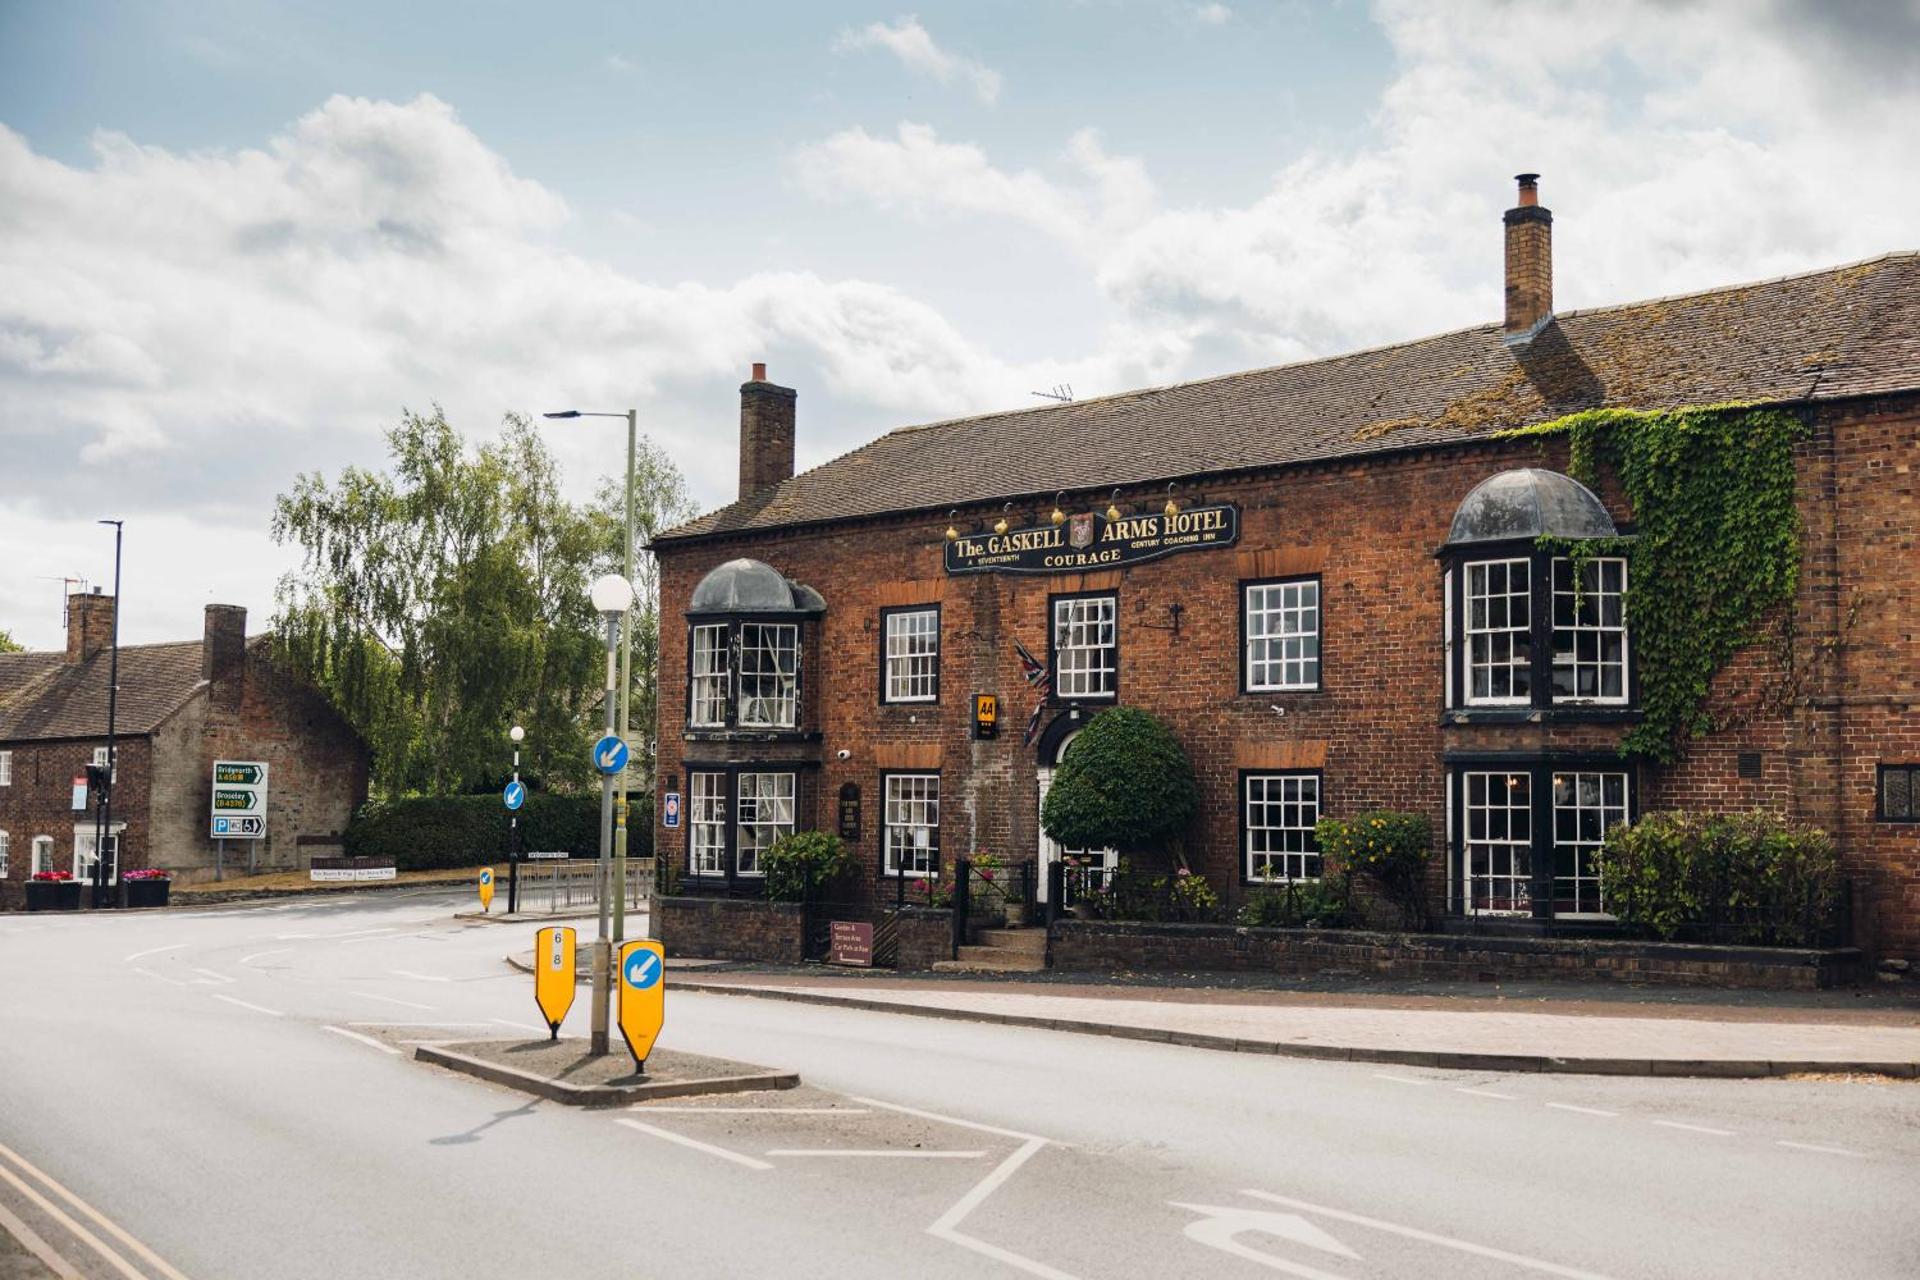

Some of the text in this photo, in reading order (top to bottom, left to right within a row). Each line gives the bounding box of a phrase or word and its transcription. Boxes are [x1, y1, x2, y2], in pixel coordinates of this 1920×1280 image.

[988, 529, 1065, 554] GASKELL
[1101, 517, 1158, 542] ARMS
[1164, 510, 1227, 535] HOTEL
[1131, 538, 1160, 549] CENTURY
[1164, 534, 1199, 545] COACHING
[1203, 532, 1216, 541] INN
[1044, 549, 1121, 567] COURAGE
[555, 933, 561, 943] 6
[554, 954, 561, 965] 8
